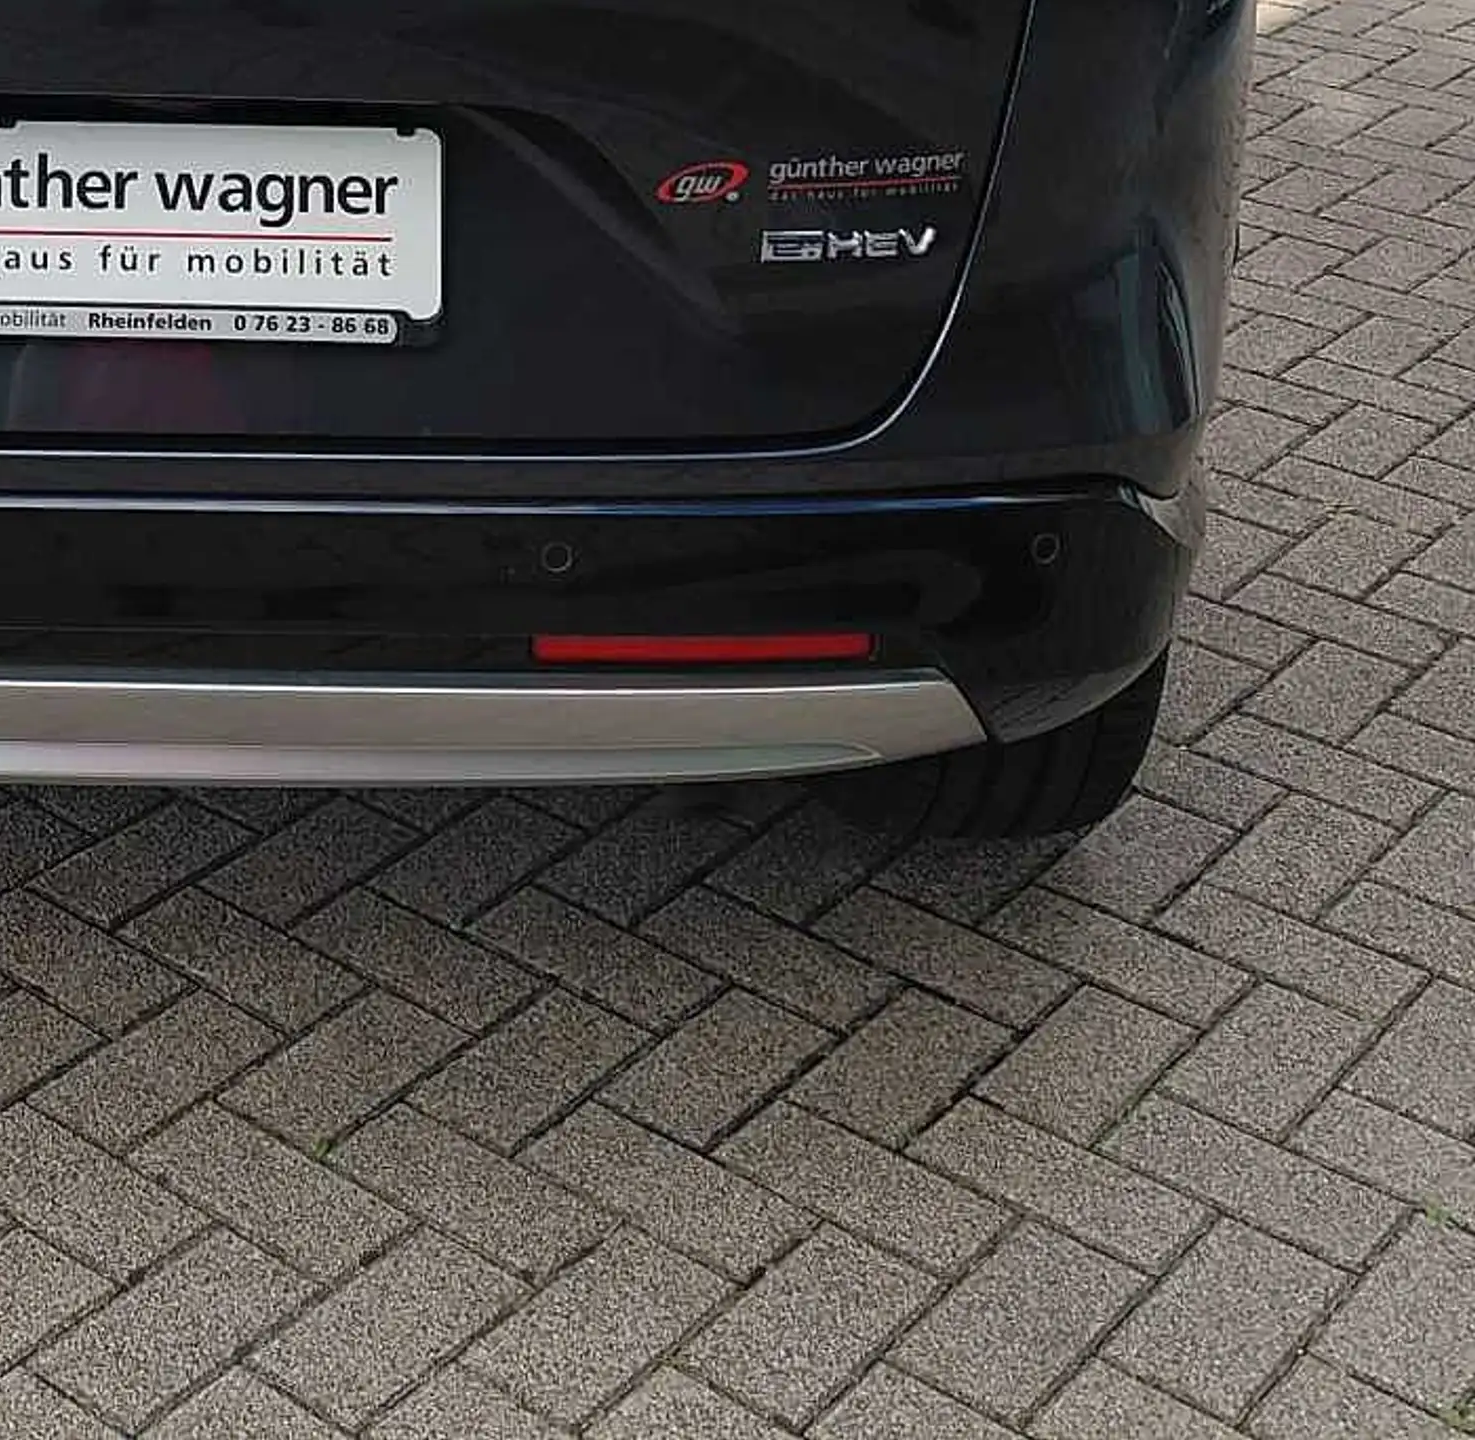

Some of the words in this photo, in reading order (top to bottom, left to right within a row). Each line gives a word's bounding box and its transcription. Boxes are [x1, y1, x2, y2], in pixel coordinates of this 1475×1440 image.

[769, 155, 869, 185] günther
[874, 151, 964, 177] wagner
[154, 171, 398, 228] wagner
[100, 245, 161, 272] für
[187, 247, 394, 277] mobilität
[88, 312, 213, 331] Rheinfelden
[233, 315, 246, 331] 0
[252, 315, 279, 332] 76
[285, 316, 311, 333] 23
[331, 316, 358, 334] 86
[363, 318, 390, 335] 68
